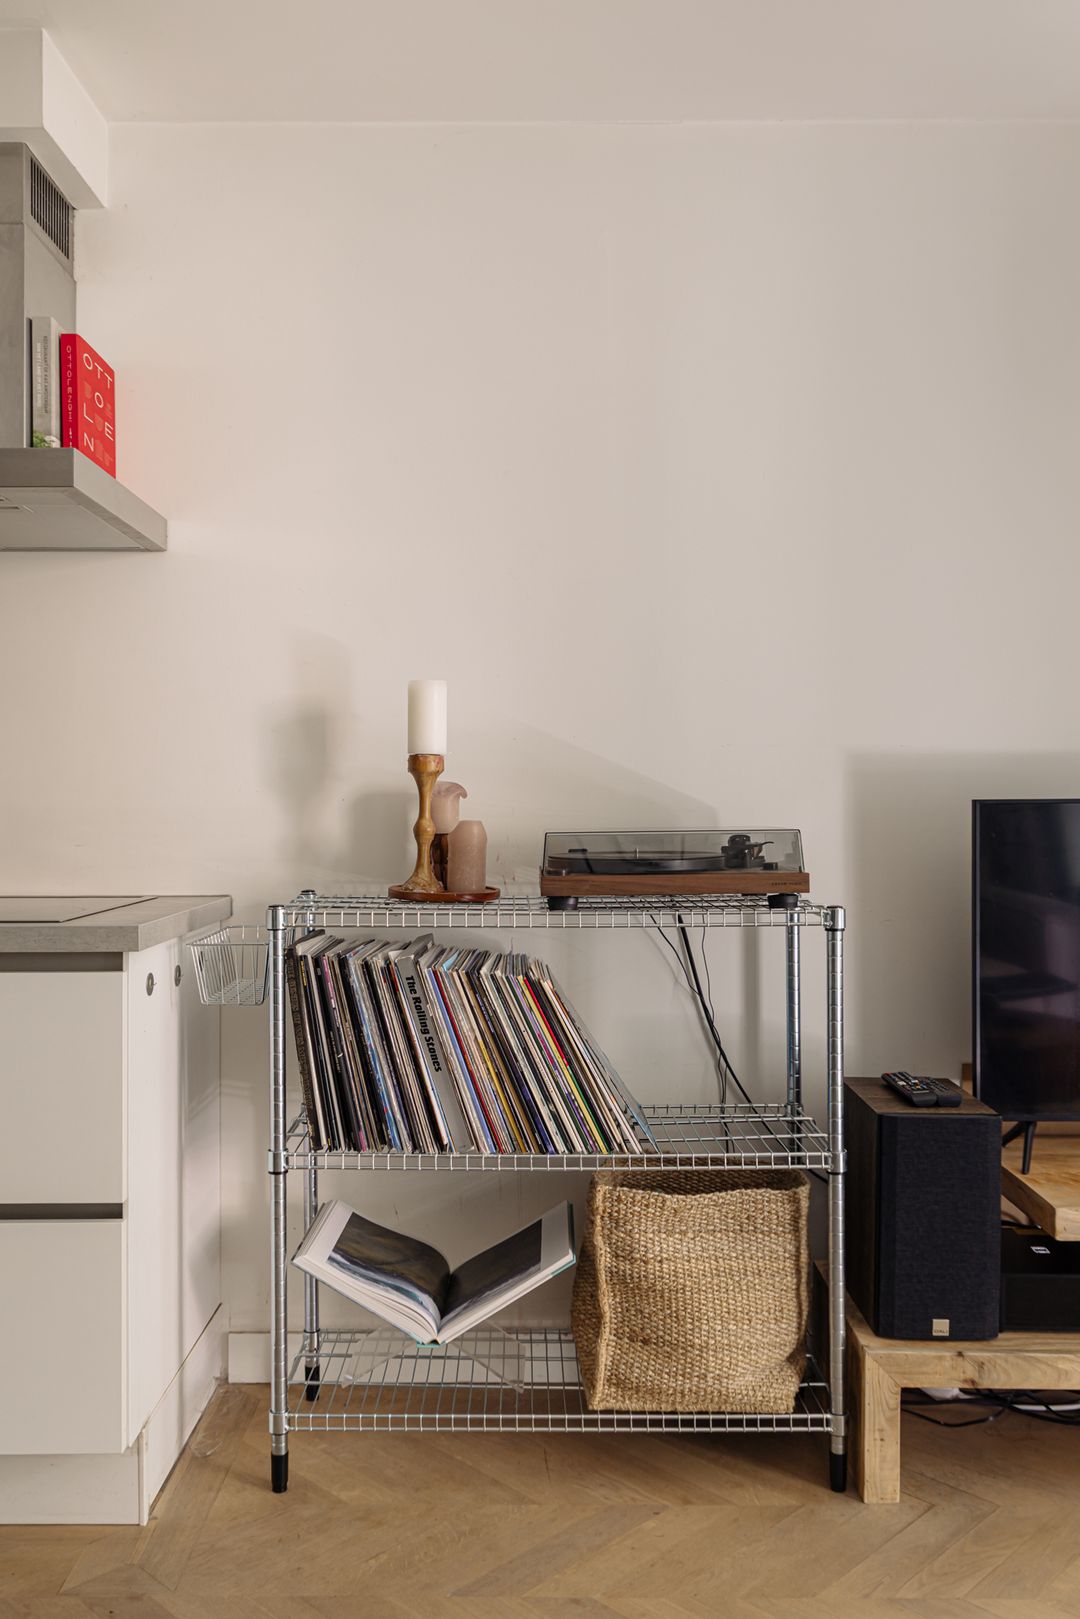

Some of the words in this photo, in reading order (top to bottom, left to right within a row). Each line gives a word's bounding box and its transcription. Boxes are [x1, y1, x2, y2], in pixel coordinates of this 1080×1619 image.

[405, 975, 417, 995] The
[412, 996, 430, 1035] Rolling
[424, 1036, 442, 1073] Stones
